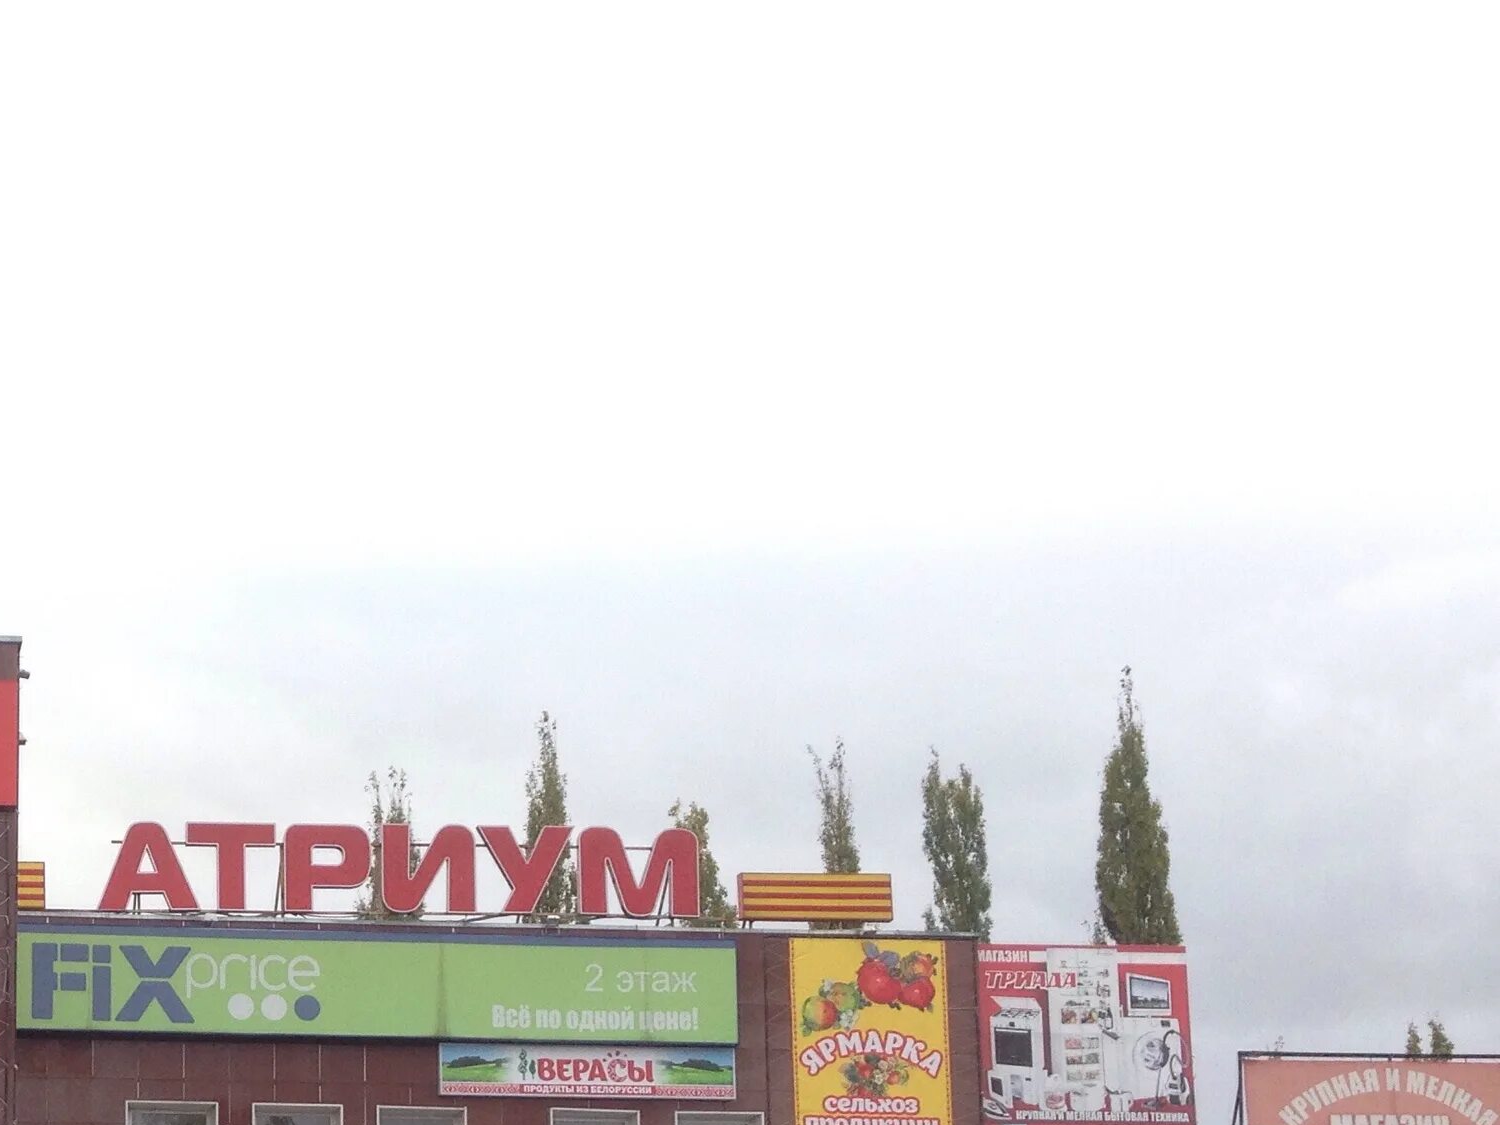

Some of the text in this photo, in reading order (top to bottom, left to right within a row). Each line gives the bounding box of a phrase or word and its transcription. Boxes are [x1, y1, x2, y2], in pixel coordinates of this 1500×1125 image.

[98, 820, 702, 918] АТРИУМ
[585, 964, 698, 993] 2 этаж
[985, 970, 1078, 989] ТРИАДА
[491, 1004, 699, 1032] Всё по одной цене!
[800, 1029, 943, 1078] ЯРМАРКА
[537, 1053, 655, 1083] ВЕРАСЫ
[1386, 1068, 1401, 1091] И
[523, 1085, 653, 1095] ПРОДУКТЫ ИЗ БЕЛОРУССИИ
[824, 1096, 919, 1114] сельхоз
[1016, 1110, 1190, 1122] КРУПНАЯ И МЕЛКАЯ БЫТОВАЯ ТЕХНИКА
